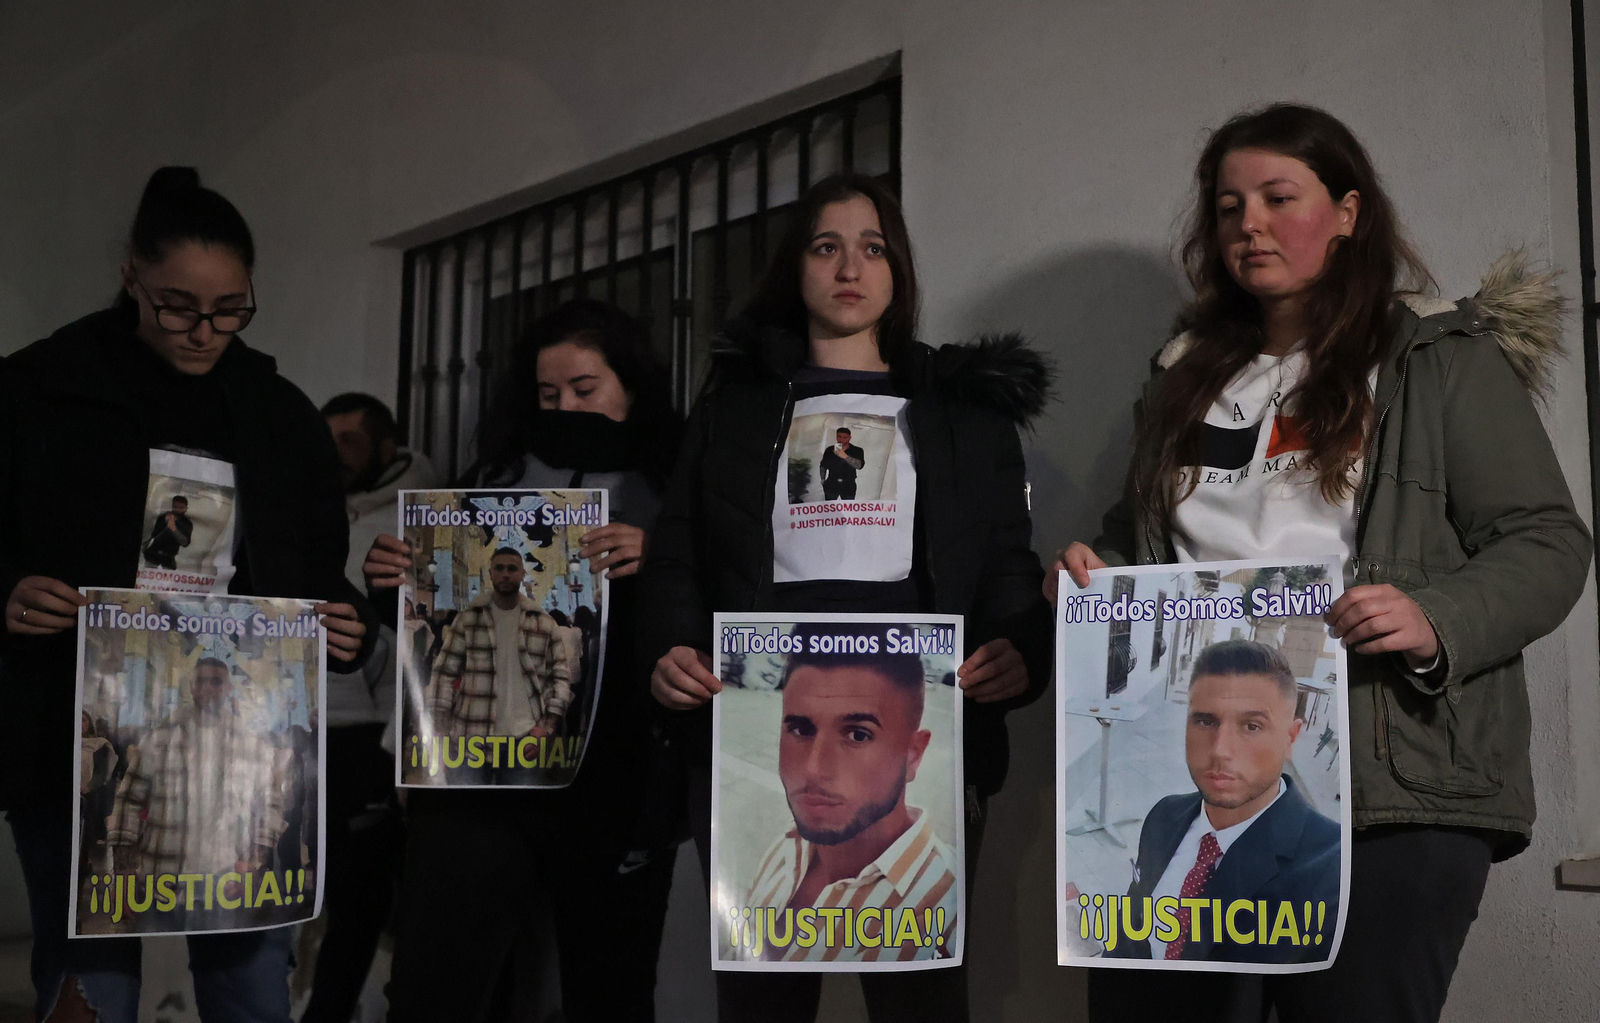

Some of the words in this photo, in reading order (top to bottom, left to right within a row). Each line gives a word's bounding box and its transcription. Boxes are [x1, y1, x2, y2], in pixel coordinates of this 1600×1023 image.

[405, 504, 472, 527] ¡¡Todos
[475, 508, 537, 527] somos
[541, 503, 600, 527] Salvi!!
[789, 504, 897, 516] #TODOSSOMOSSALVI
[790, 517, 896, 530] #JUSTICIAPARASALVI
[88, 603, 171, 632] ¡¡Todos
[177, 614, 247, 637] somos
[252, 611, 318, 638] Salvi!!
[1065, 591, 1157, 624] ¡¡Todos
[1162, 595, 1245, 621] somos
[1251, 583, 1332, 619] Salvi!!
[722, 626, 804, 655] ¡¡Todos
[808, 632, 881, 655] somos
[885, 627, 955, 655] Salvi!!
[411, 734, 582, 777] ¡¡JUSTICIA!!
[89, 868, 306, 924] ¡¡JUSTICIA!!
[729, 906, 946, 958] ¡¡JUSTICIA!!
[1078, 893, 1327, 952] ¡¡JUSTICIA!!
